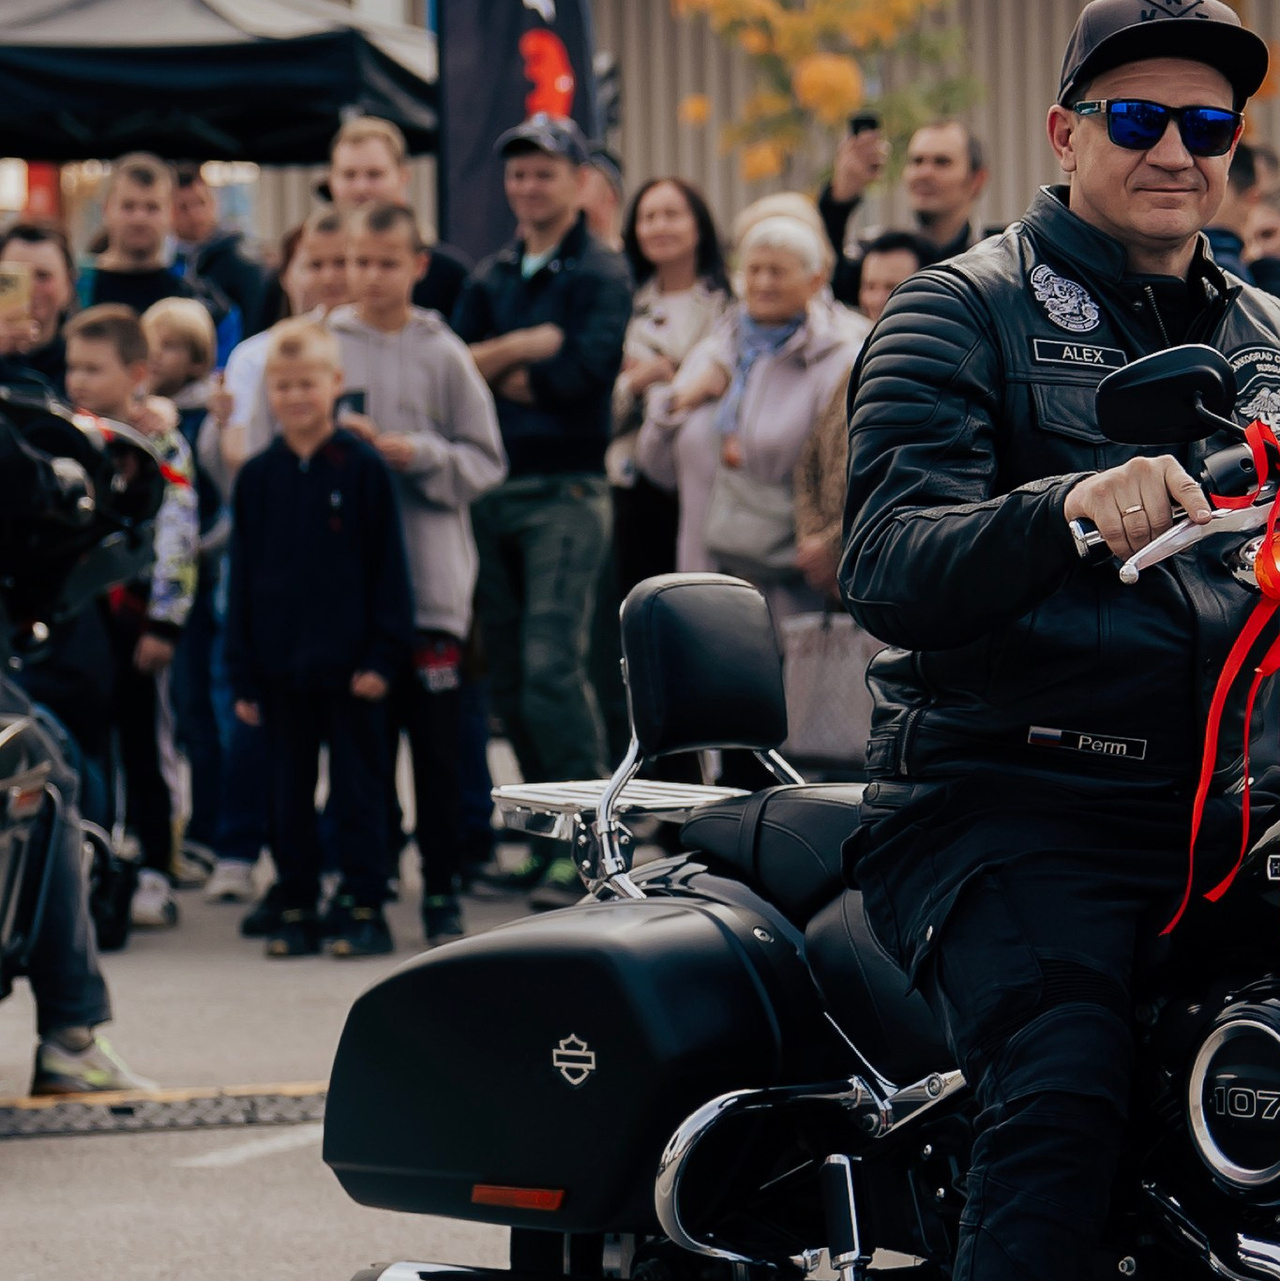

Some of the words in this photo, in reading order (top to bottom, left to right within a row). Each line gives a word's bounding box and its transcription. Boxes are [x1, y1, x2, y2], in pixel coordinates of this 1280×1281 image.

[1062, 346, 1105, 364] ALEX
[1231, 351, 1273, 373] ANKOGRAD
[1078, 735, 1128, 756] Perm
